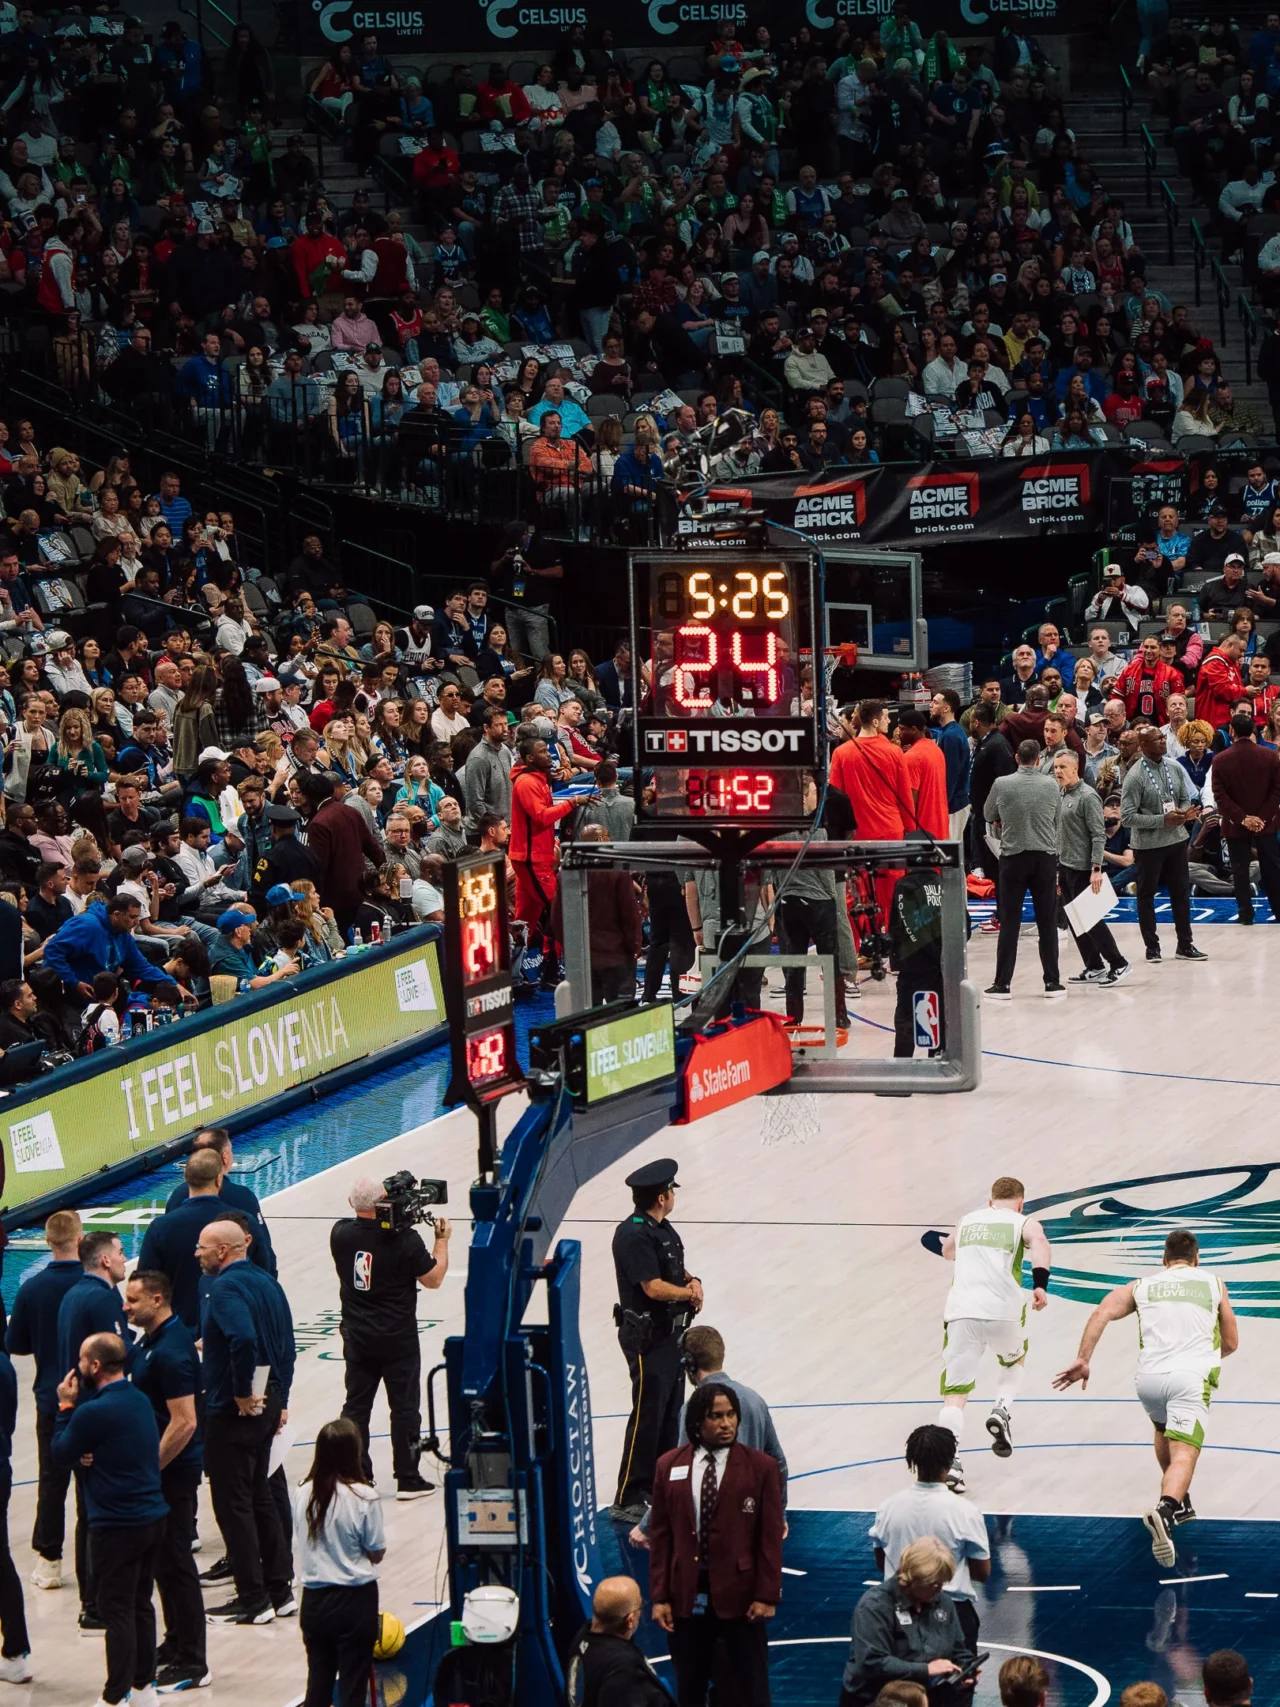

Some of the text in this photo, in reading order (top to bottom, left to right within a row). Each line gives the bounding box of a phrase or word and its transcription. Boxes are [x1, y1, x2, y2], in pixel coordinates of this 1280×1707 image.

[352, 10, 424, 30] CELSIUS
[518, 7, 587, 25] CELSIUS
[679, 3, 747, 21] CELSIUS
[396, 28, 423, 36] LIVE FIT
[975, 390, 997, 411] NBA
[1020, 477, 1079, 496] ACME
[794, 495, 855, 513] ACME
[909, 486, 968, 508] ACME
[1021, 494, 1080, 512] BRICK
[793, 510, 856, 529] BRICK
[908, 503, 969, 522] BRICK
[1028, 513, 1085, 525] brick.com
[1250, 507, 1265, 516] 77
[914, 521, 975, 535] brick.com
[688, 572, 790, 619] 5:25
[674, 626, 777, 708] 24
[689, 729, 805, 752] TISSOT
[718, 775, 773, 810] 1:52
[897, 894, 917, 943] POLICE
[466, 920, 494, 973] 24
[598, 1045, 621, 1071] FEEL
[622, 1028, 669, 1068] SLOVENIA
[120, 996, 349, 1141] I FEEL SLOVENIA
[18, 1124, 37, 1142] FEEL
[566, 1362, 589, 1574] CHOCTAW
